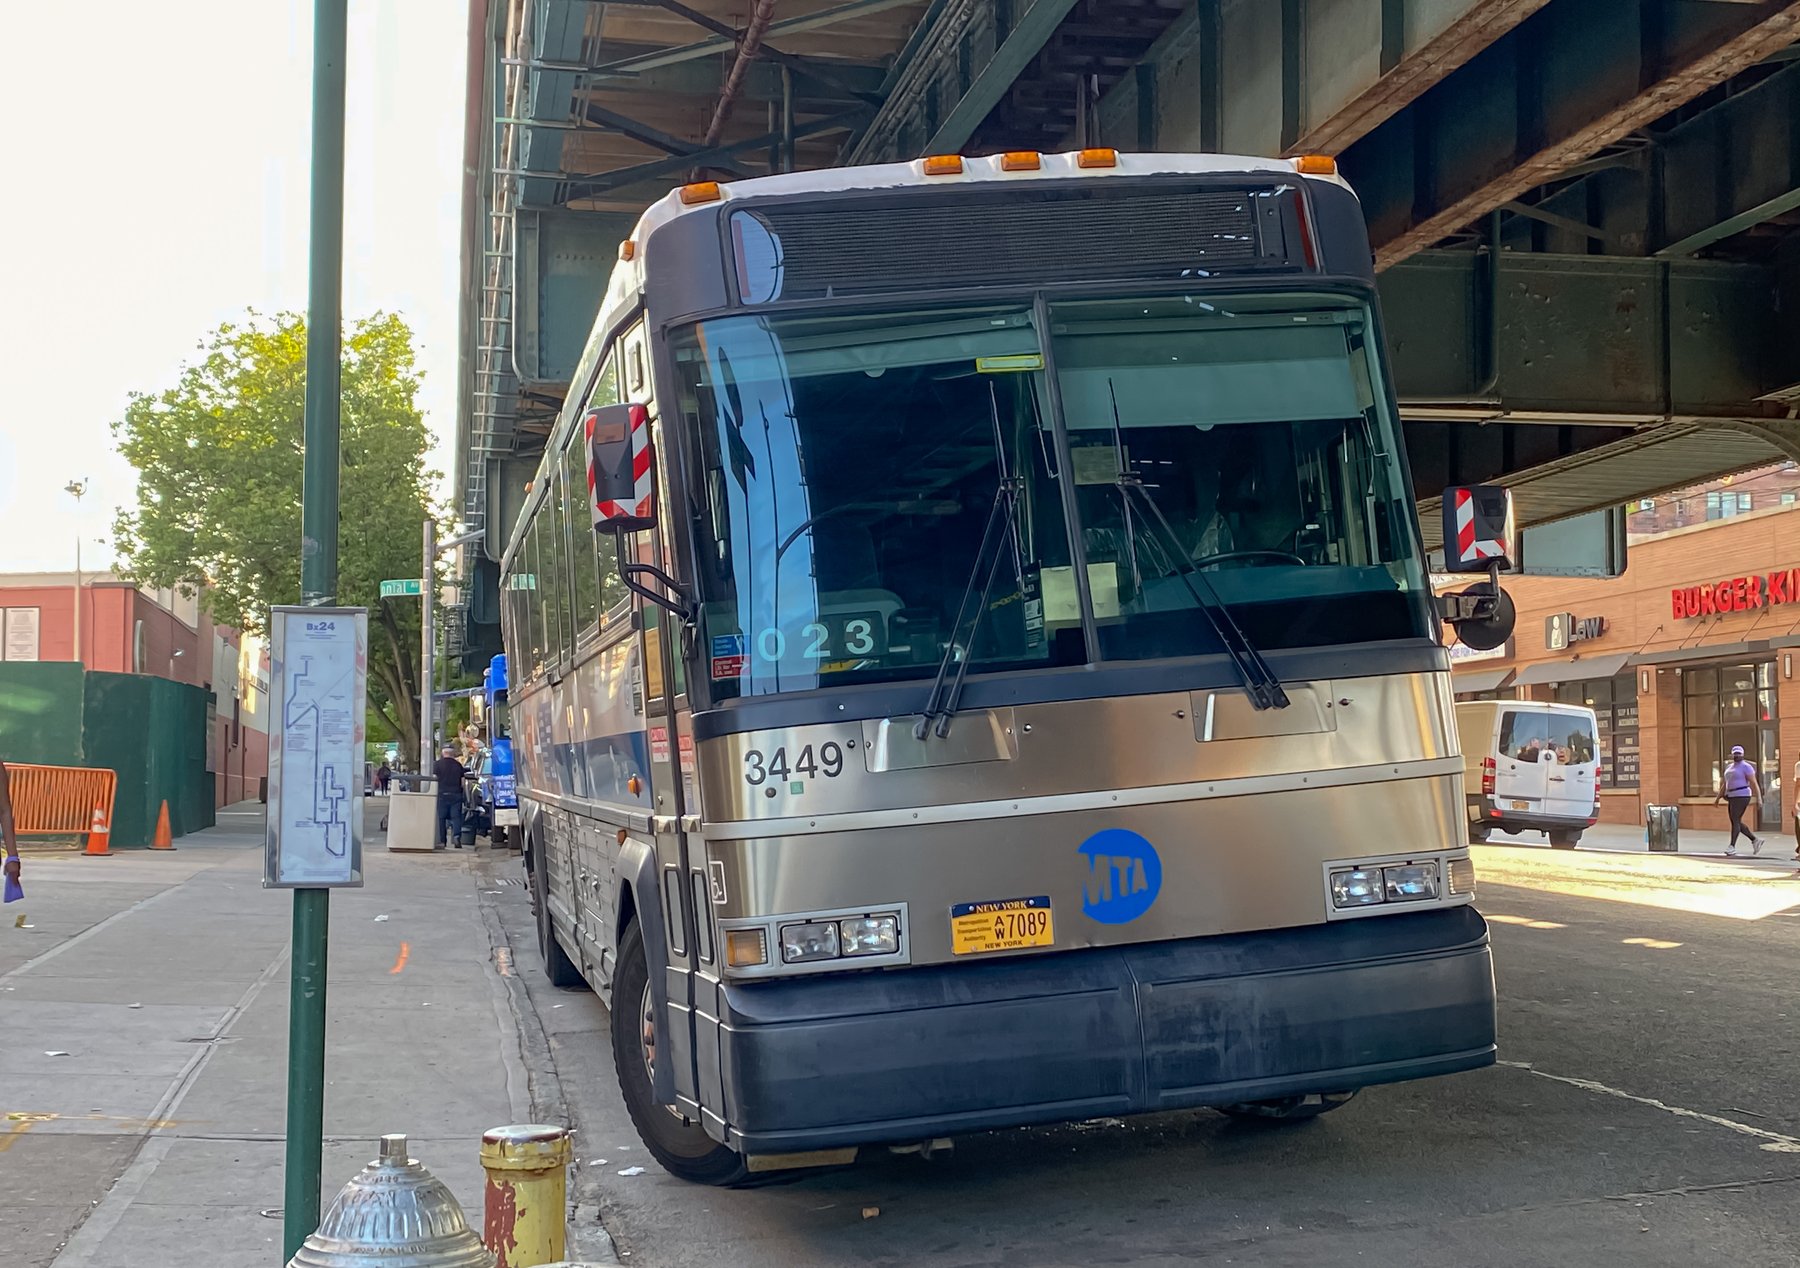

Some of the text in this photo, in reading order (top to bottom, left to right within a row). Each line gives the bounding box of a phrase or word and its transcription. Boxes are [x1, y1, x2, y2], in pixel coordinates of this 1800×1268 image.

[1672, 576, 1763, 620] BURGER
[306, 621, 336, 631] Bx24
[744, 741, 843, 785] 3449
[1077, 852, 1149, 906] MTA
[976, 900, 1028, 914] NEW YORK
[984, 940, 1024, 950] NEW YORK
